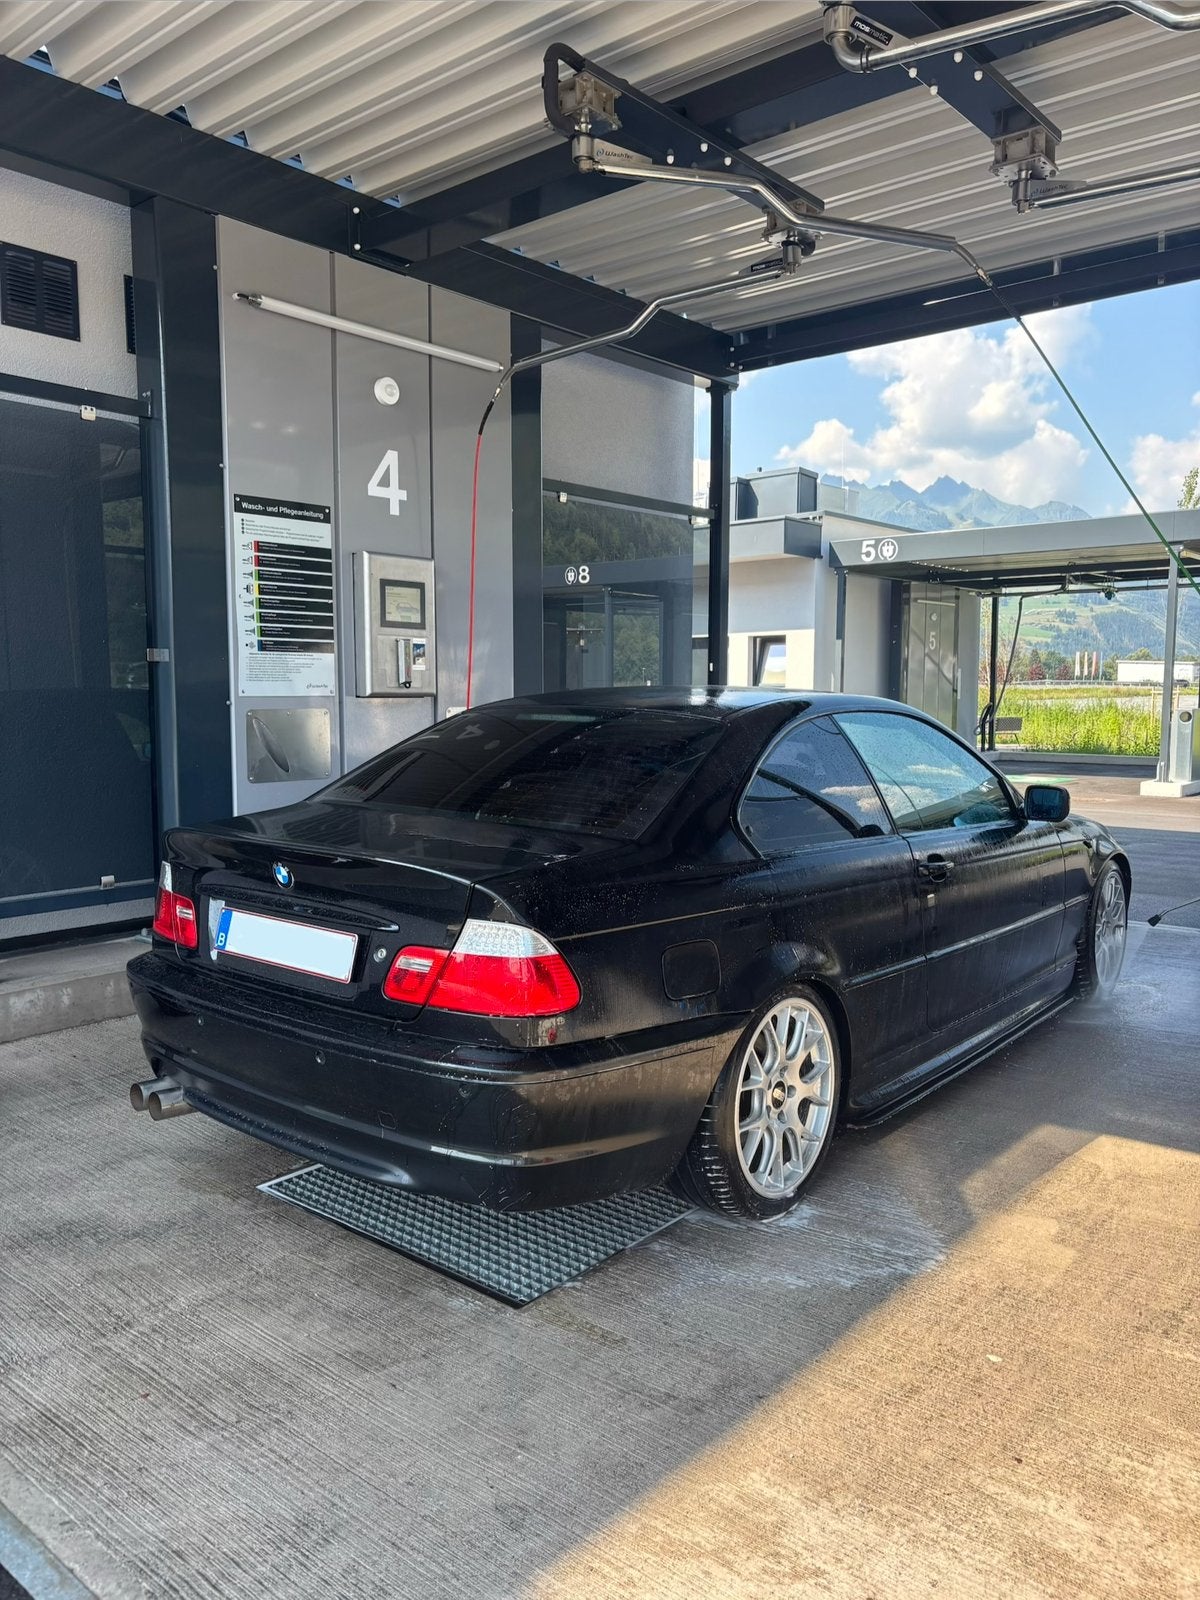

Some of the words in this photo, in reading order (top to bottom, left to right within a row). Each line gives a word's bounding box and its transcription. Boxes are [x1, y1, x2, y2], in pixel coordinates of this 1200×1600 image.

[367, 449, 407, 516] 4
[241, 502, 265, 511] Wasch-
[279, 506, 324, 520] Pflegeanleitung
[861, 540, 876, 562] 5
[578, 565, 590, 584] 8
[928, 631, 937, 650] 5
[217, 932, 226, 946] B
